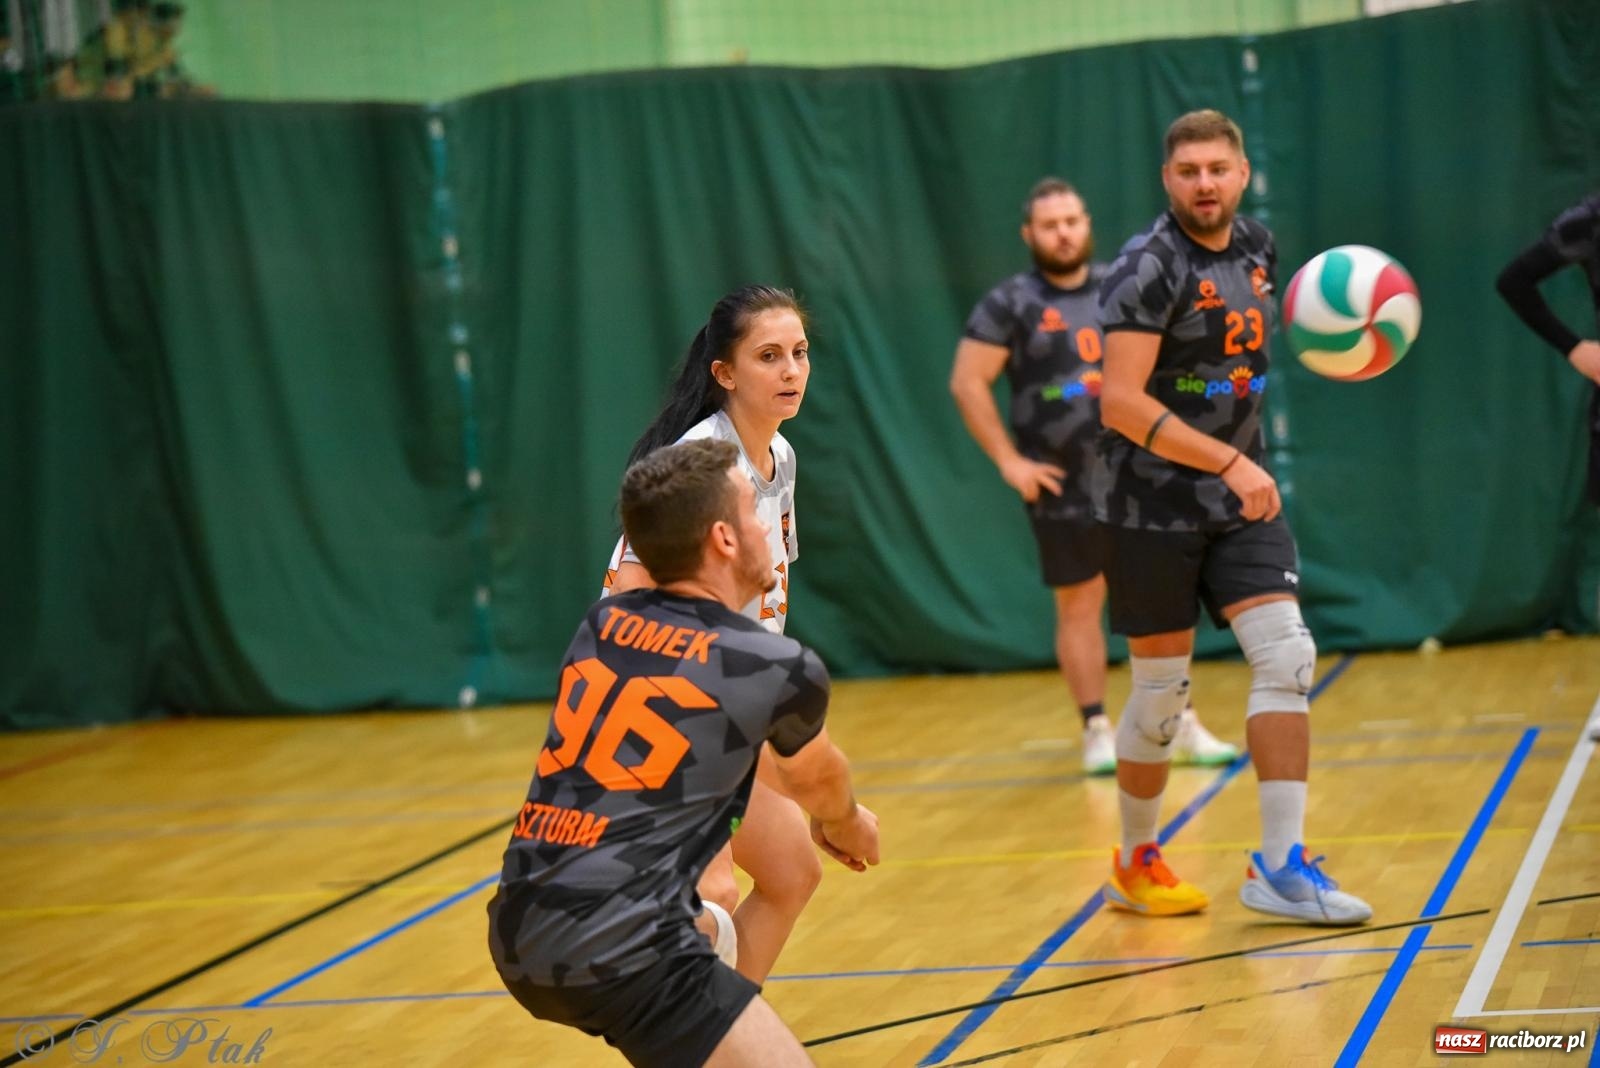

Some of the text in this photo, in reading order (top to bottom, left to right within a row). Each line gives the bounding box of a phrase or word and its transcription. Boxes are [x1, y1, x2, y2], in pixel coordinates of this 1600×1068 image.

[1224, 307, 1264, 356] 23
[600, 606, 720, 664] TOMEK
[537, 656, 720, 791] 96
[513, 801, 611, 848] SZTURM
